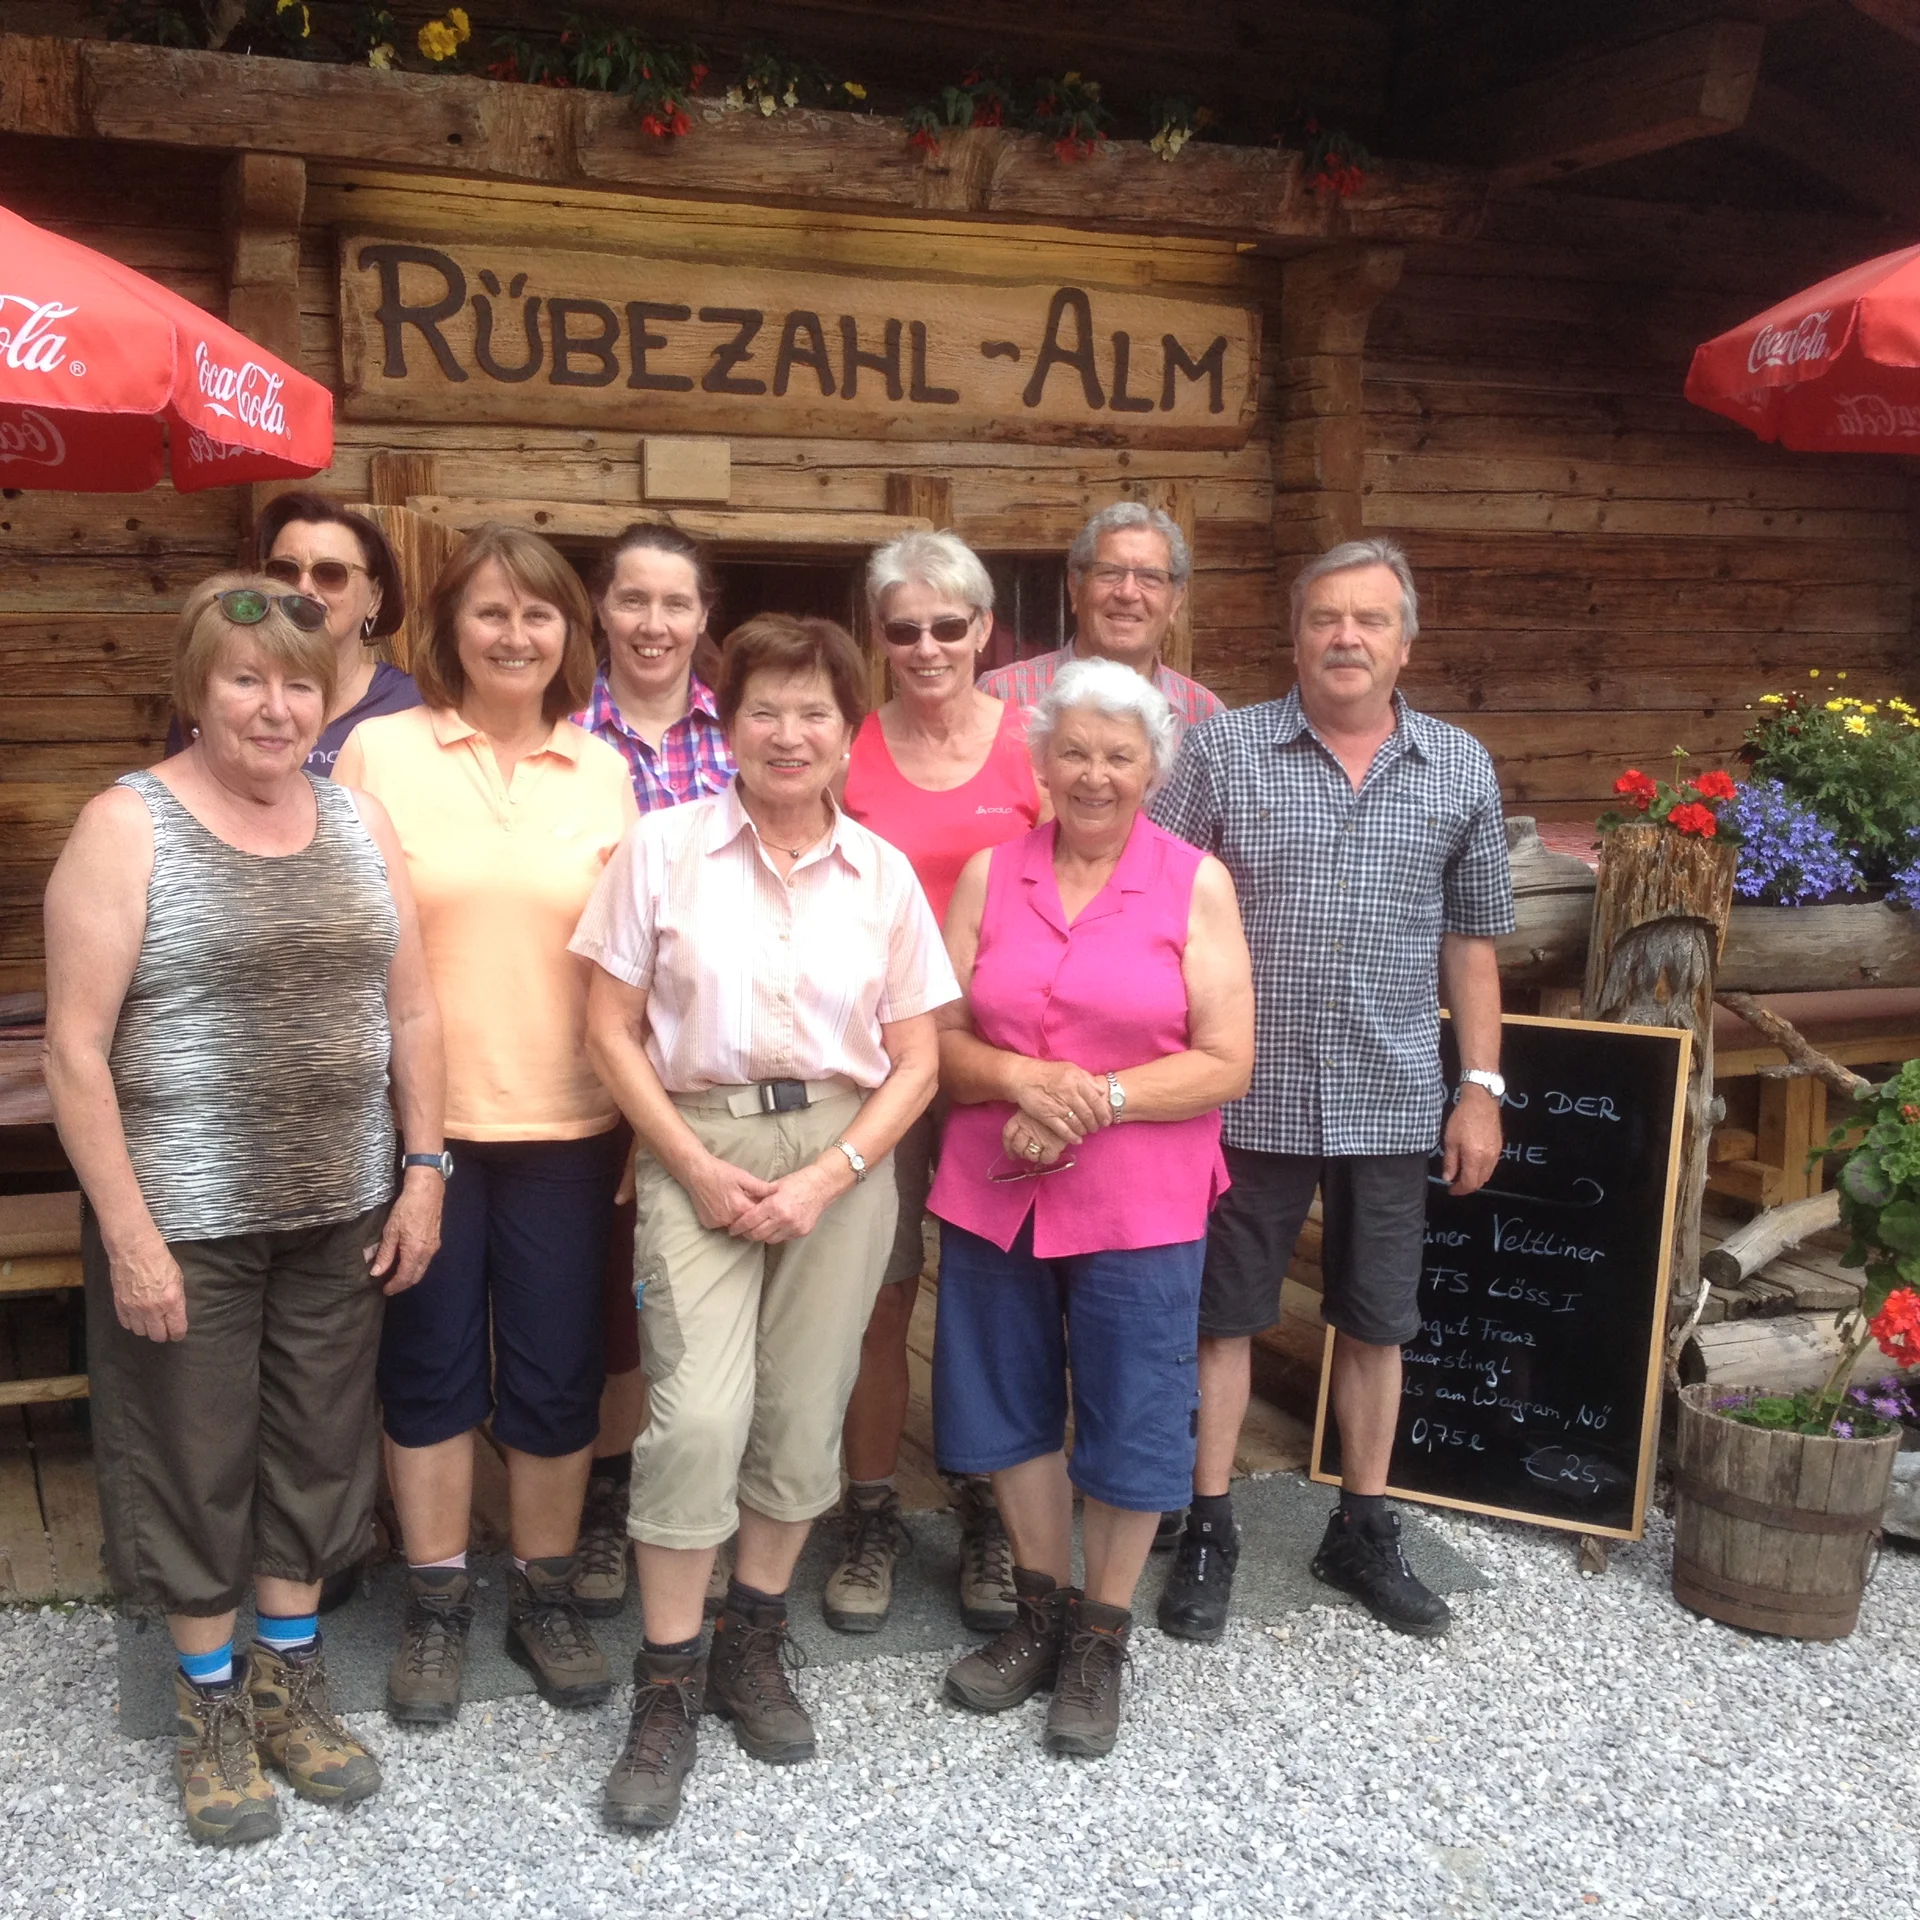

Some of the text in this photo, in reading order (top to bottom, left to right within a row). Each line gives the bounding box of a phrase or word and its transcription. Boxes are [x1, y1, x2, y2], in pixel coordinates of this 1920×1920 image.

[1544, 1091, 1621, 1122] DER
[1493, 1213, 1606, 1263] Veltliner
[1435, 1387, 1467, 1402] am
